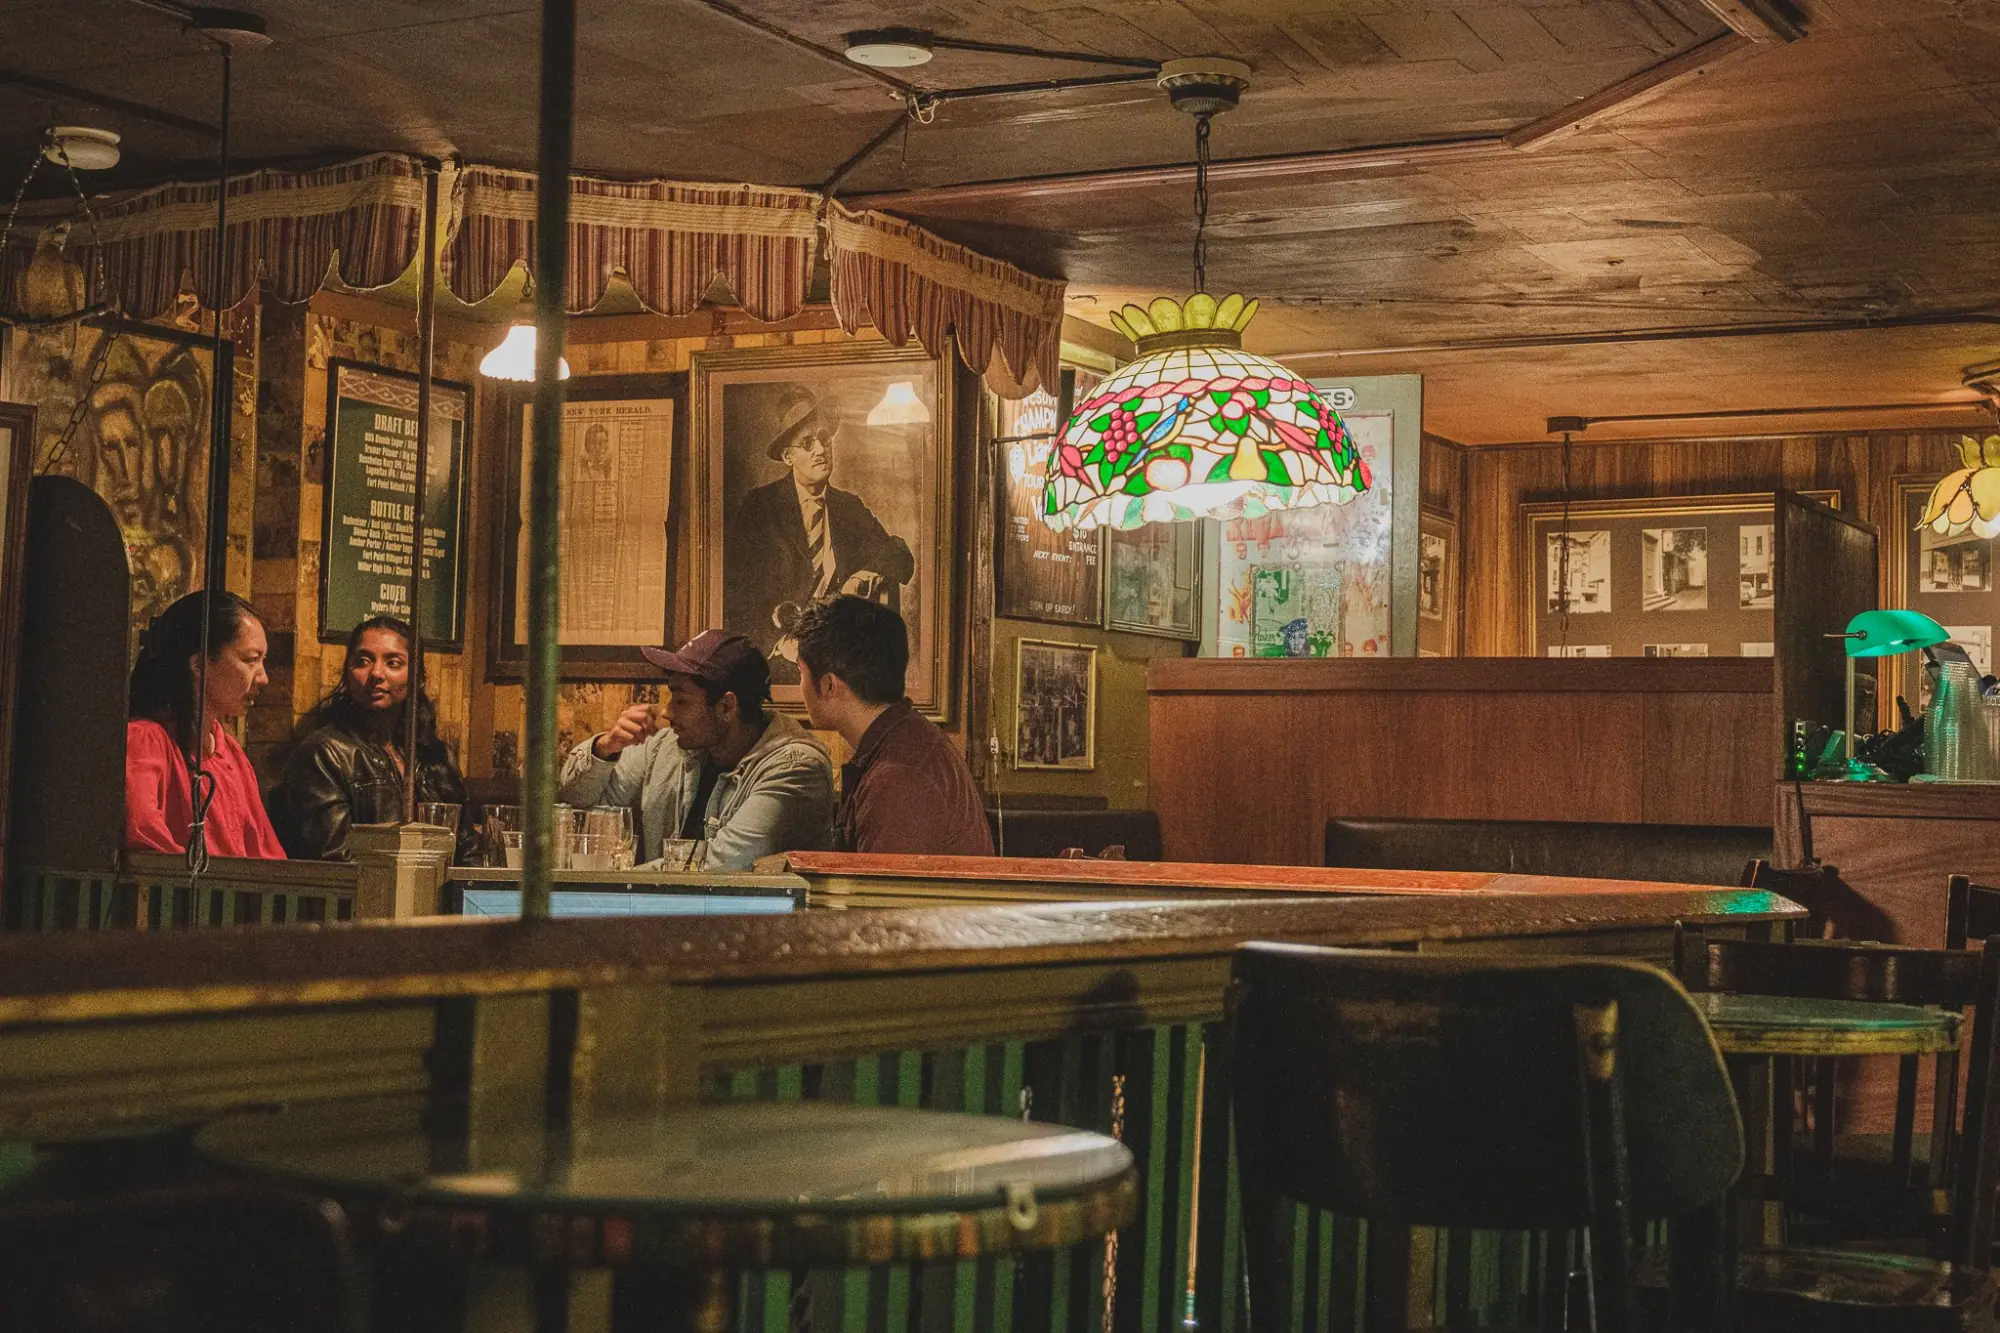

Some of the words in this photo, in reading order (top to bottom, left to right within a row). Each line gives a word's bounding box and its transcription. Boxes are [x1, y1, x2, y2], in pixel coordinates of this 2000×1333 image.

[566, 408, 584, 416] NEW
[589, 407, 612, 415] YORK
[375, 413, 403, 434] DRAFT
[404, 419, 419, 437] BE
[370, 500, 401, 520] BOTTLE
[1069, 541, 1097, 554] ENTRANCE
[1033, 550, 1050, 560] NEXT
[1086, 555, 1096, 566] FEE
[380, 583, 406, 602] CIDER
[1045, 602, 1054, 613] UP
